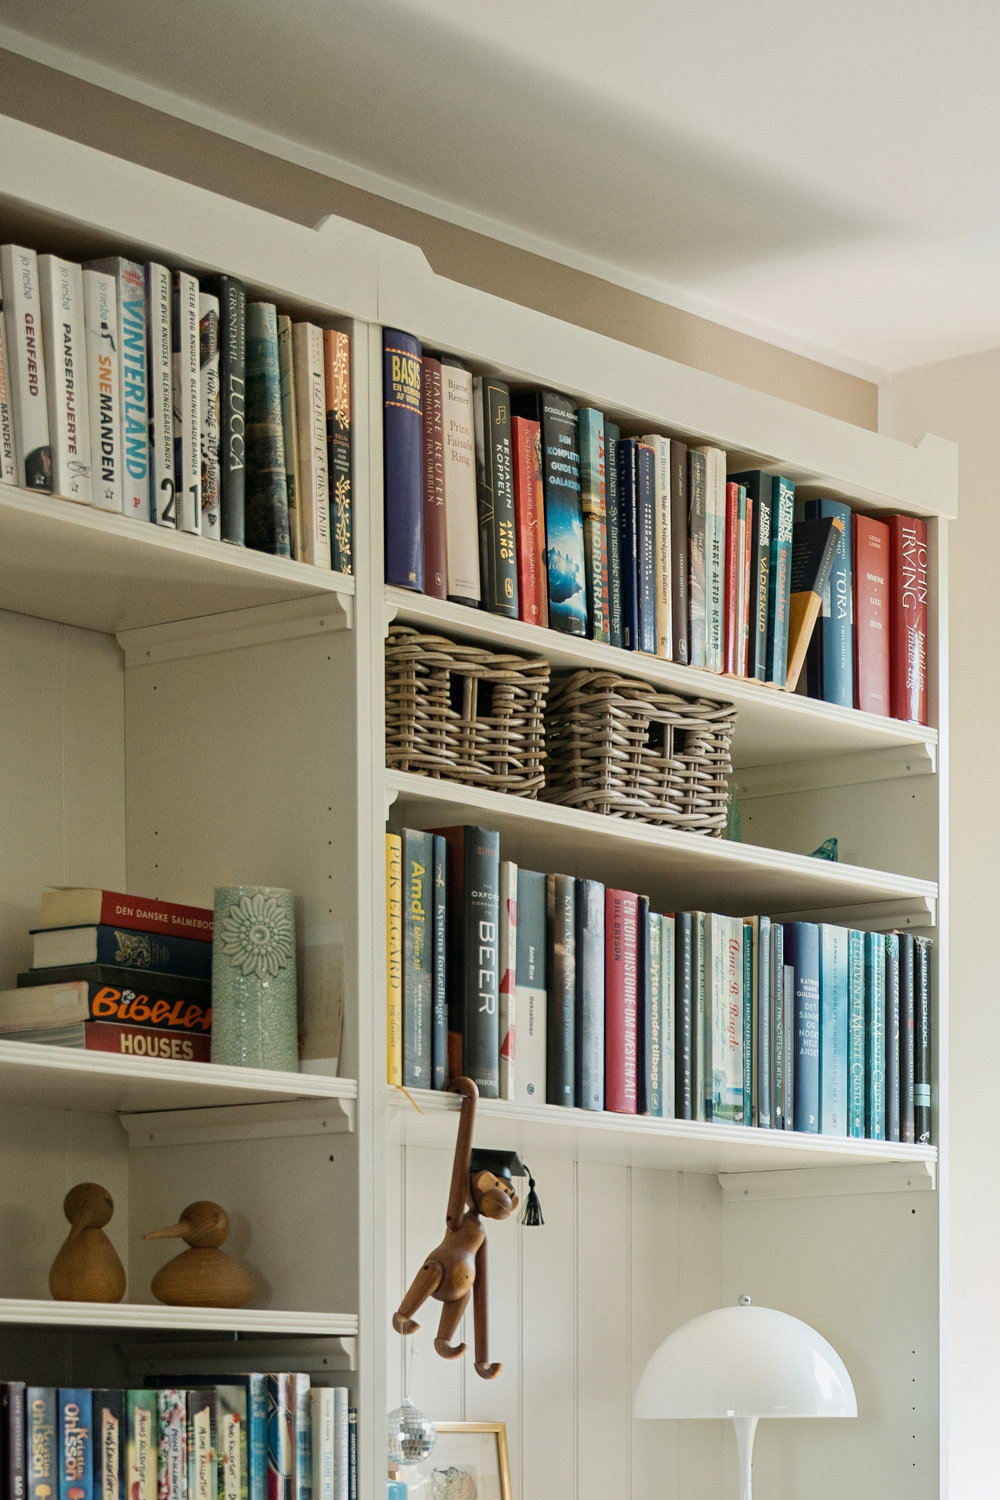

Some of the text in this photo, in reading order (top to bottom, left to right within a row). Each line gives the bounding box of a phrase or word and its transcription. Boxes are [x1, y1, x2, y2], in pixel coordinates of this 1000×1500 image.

[160, 274, 168, 301] PETER
[161, 327, 169, 367] KNUDSEN
[188, 281, 197, 374] PETER KNUDSEN
[24, 313, 38, 396] GENFÆRD
[392, 355, 420, 390] BASIS
[63, 323, 77, 455] PANSERHJERTE
[122, 300, 146, 480] VINTERLAND
[98, 355, 115, 482] SNEMANDEN
[229, 374, 245, 472] LUCCA
[424, 370, 434, 503] LØGNHALSEN FRA UMBRIEN
[432, 372, 444, 508] BJARNE REUTER
[559, 434, 571, 445] DEN
[452, 450, 471, 468] Ring
[496, 444, 505, 497] KOPPEL
[503, 438, 512, 509] BENJAMIN
[551, 461, 572, 474] GUIDE
[160, 478, 175, 523] 2
[608, 438, 620, 576] Karen Blixen Syv fantastiske
[778, 483, 787, 543] ENGBERG
[785, 490, 794, 543] KATRINE
[499, 521, 508, 559] SANG
[592, 523, 603, 632] NORDKRAFT
[759, 557, 769, 632] VÅDESKUD
[778, 549, 787, 622] BLODMÅNE
[836, 568, 847, 619] TORA
[902, 528, 917, 610] IRVING
[916, 541, 927, 606] JOHN
[711, 610, 719, 650] KAVIAR
[390, 845, 401, 889] PUK
[411, 861, 425, 922] Amdi
[115, 905, 214, 931] DEN DANSKE SALMEBOG
[436, 904, 445, 953] Kystens
[564, 895, 572, 990] KATE ATKINSON
[478, 920, 496, 1015] BEER
[650, 960, 660, 989] Jytte
[624, 900, 636, 1100] EN KORT HISTORIE OM NÆSTEN ALT
[651, 990, 659, 1043] vender
[727, 938, 740, 1052] Anne B. Ragde
[120, 1032, 193, 1061] HOUSES
[806, 1020, 816, 1029] OG
[852, 950, 863, 1106] GREVEN MONTE CRISTO
[651, 1045, 660, 1089] tilbage
[873, 1070, 883, 1113] CRISTO
[43, 1425, 55, 1477] Kristina
[15, 1476, 23, 1495] BAG
